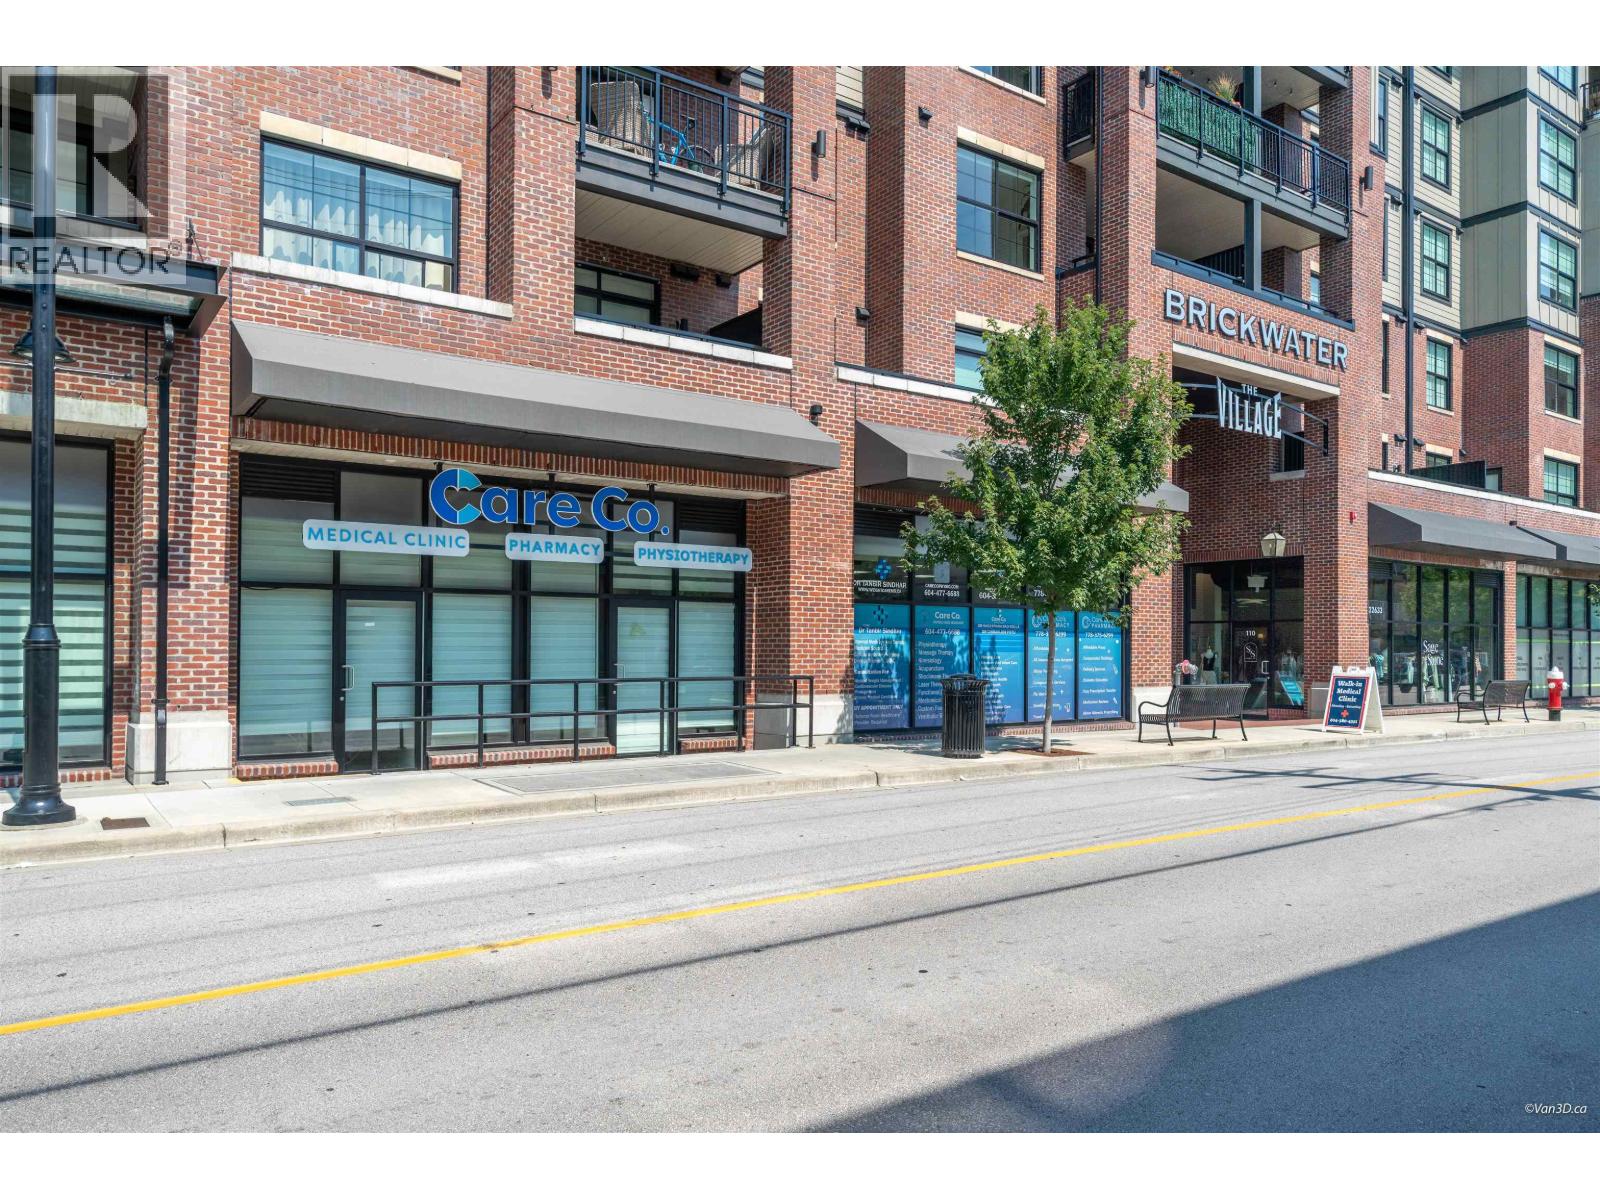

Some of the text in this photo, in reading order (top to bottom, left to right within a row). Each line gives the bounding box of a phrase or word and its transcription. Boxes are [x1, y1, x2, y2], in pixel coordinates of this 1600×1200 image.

[1165, 288, 1348, 370] BRICKWATER
[1242, 384, 1258, 395] THE
[1216, 376, 1282, 439] VILLAGE
[429, 467, 670, 536] Care Co.
[307, 527, 467, 549] MEDICAL CLINIC
[508, 539, 601, 557] PHARMACY
[637, 547, 749, 566] PHYSIOTHERAPY
